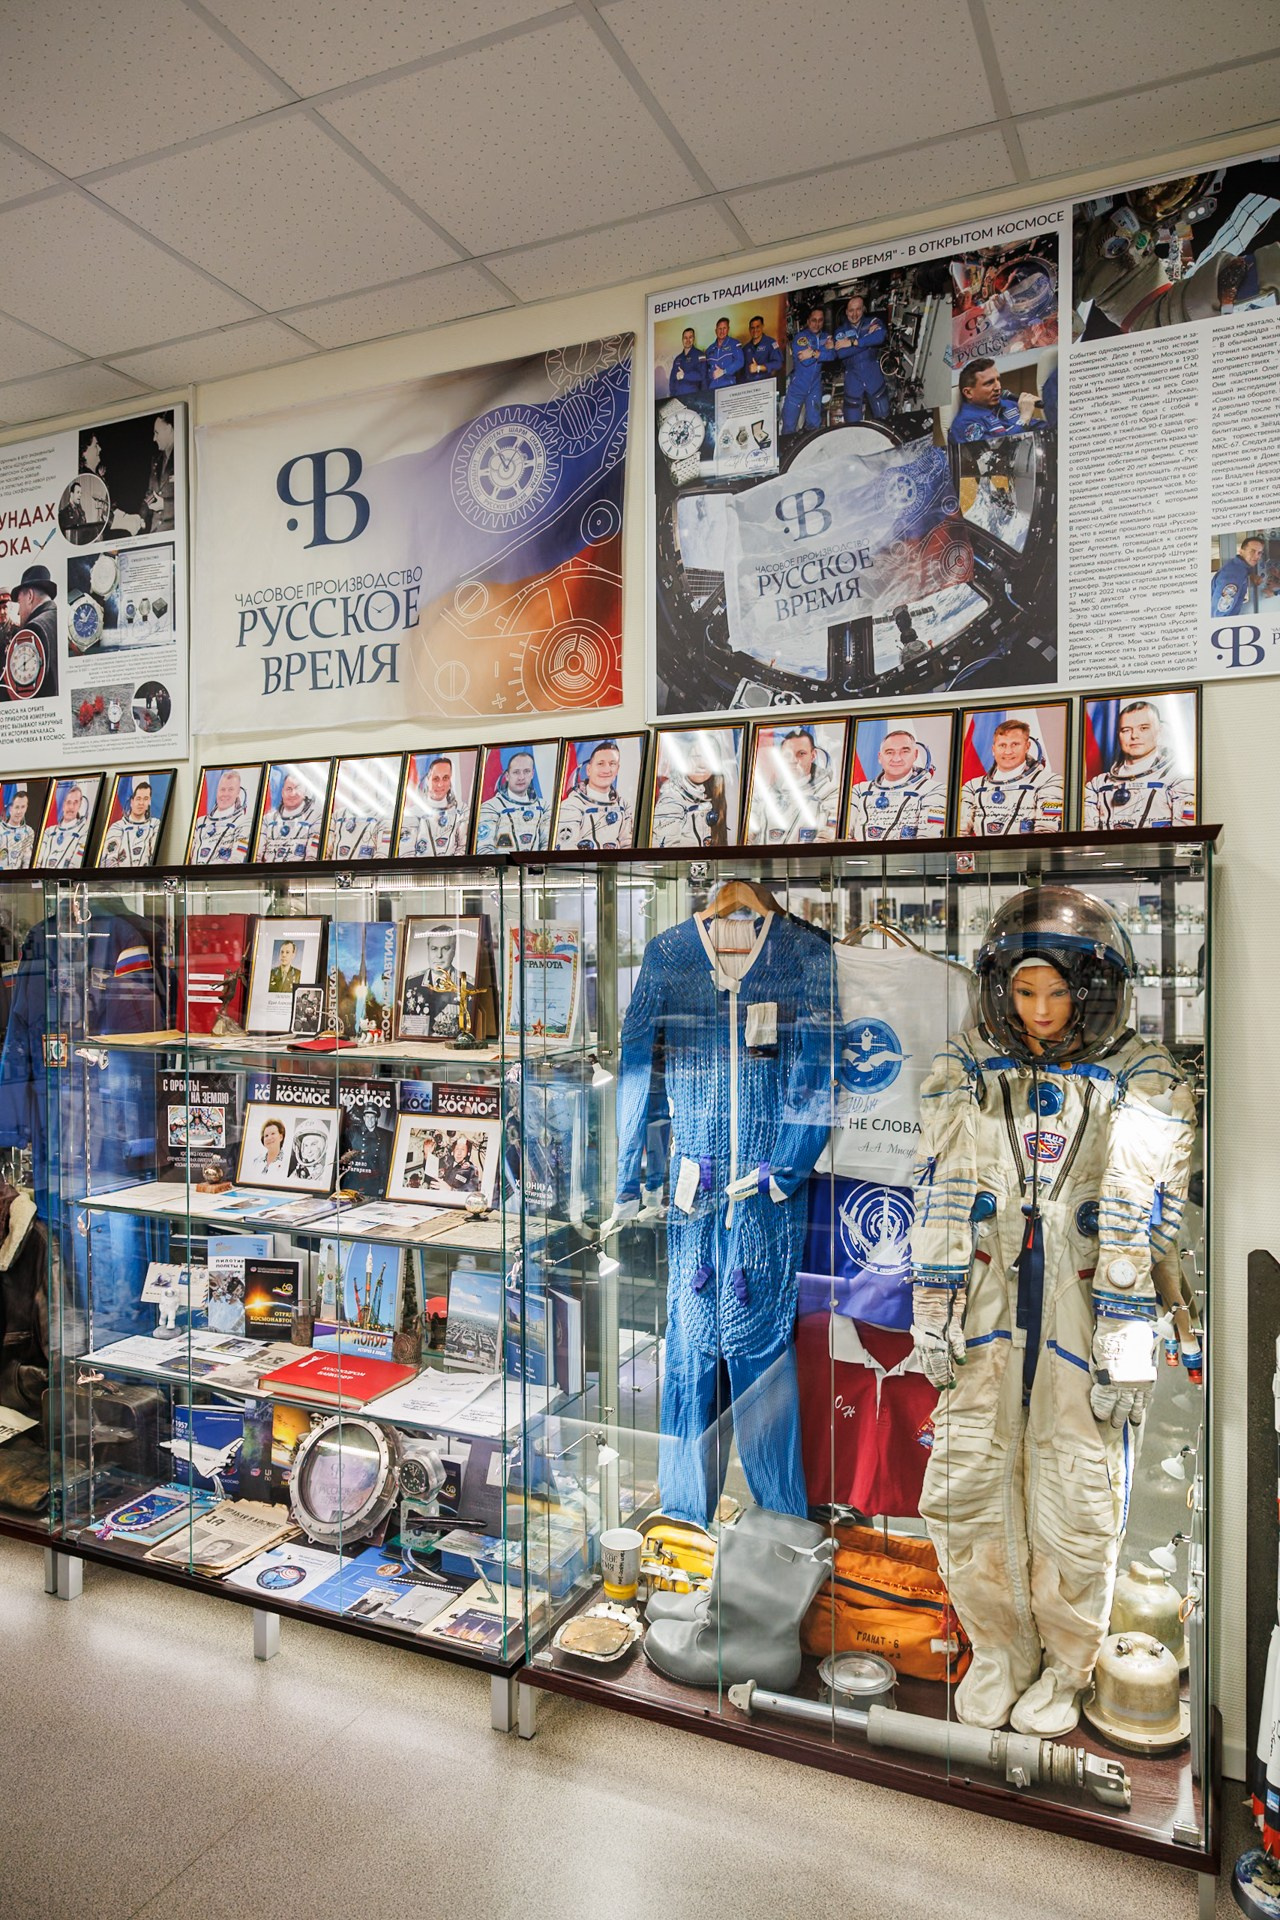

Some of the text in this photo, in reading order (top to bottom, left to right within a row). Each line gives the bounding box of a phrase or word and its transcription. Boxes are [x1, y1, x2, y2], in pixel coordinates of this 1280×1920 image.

[654, 294, 710, 314] ВЕРНОСТЬ
[712, 274, 789, 301] ТРАДИЦИЯМ:
[791, 259, 849, 282] "РУССКОЕ
[851, 249, 898, 269] ВРЕМЯ"
[908, 245, 917, 256] В
[919, 227, 993, 253] ОТКРЫТОМ
[997, 210, 1065, 236] КОСМОСЕ
[508, 426, 528, 436] ШАРМ
[477, 429, 504, 455] PRESIDENT
[529, 436, 543, 458] CHARM
[530, 463, 543, 489] ШТУРМ
[483, 493, 528, 510] РУССКОЕ ВРЕМЯ
[755, 537, 870, 572] ЧАСОВОЕ ПРОИЗВОДСТВО
[757, 547, 874, 597] РУССКОЕ
[235, 566, 422, 607] ЧАСОВОЕ ПРОИЗВОДСТВО
[776, 577, 863, 622] ВРЕМЯ
[235, 585, 421, 648] РУССКОЕ
[261, 643, 401, 695] ВРЕМЯ
[163, 1079, 168, 1091] С
[190, 1092, 229, 1104] НА ЗЕМЛЮ
[276, 1091, 330, 1105] КОСМОС
[339, 1093, 391, 1109] КОСМОС
[438, 1100, 498, 1115] КОСМОС
[849, 1118, 867, 1130] НЕ
[872, 1119, 922, 1134] СЛОВА
[1044, 1133, 1064, 1142] МИР
[856, 1631, 886, 1645] ГРАНАТ
[893, 1639, 899, 1649] 6
